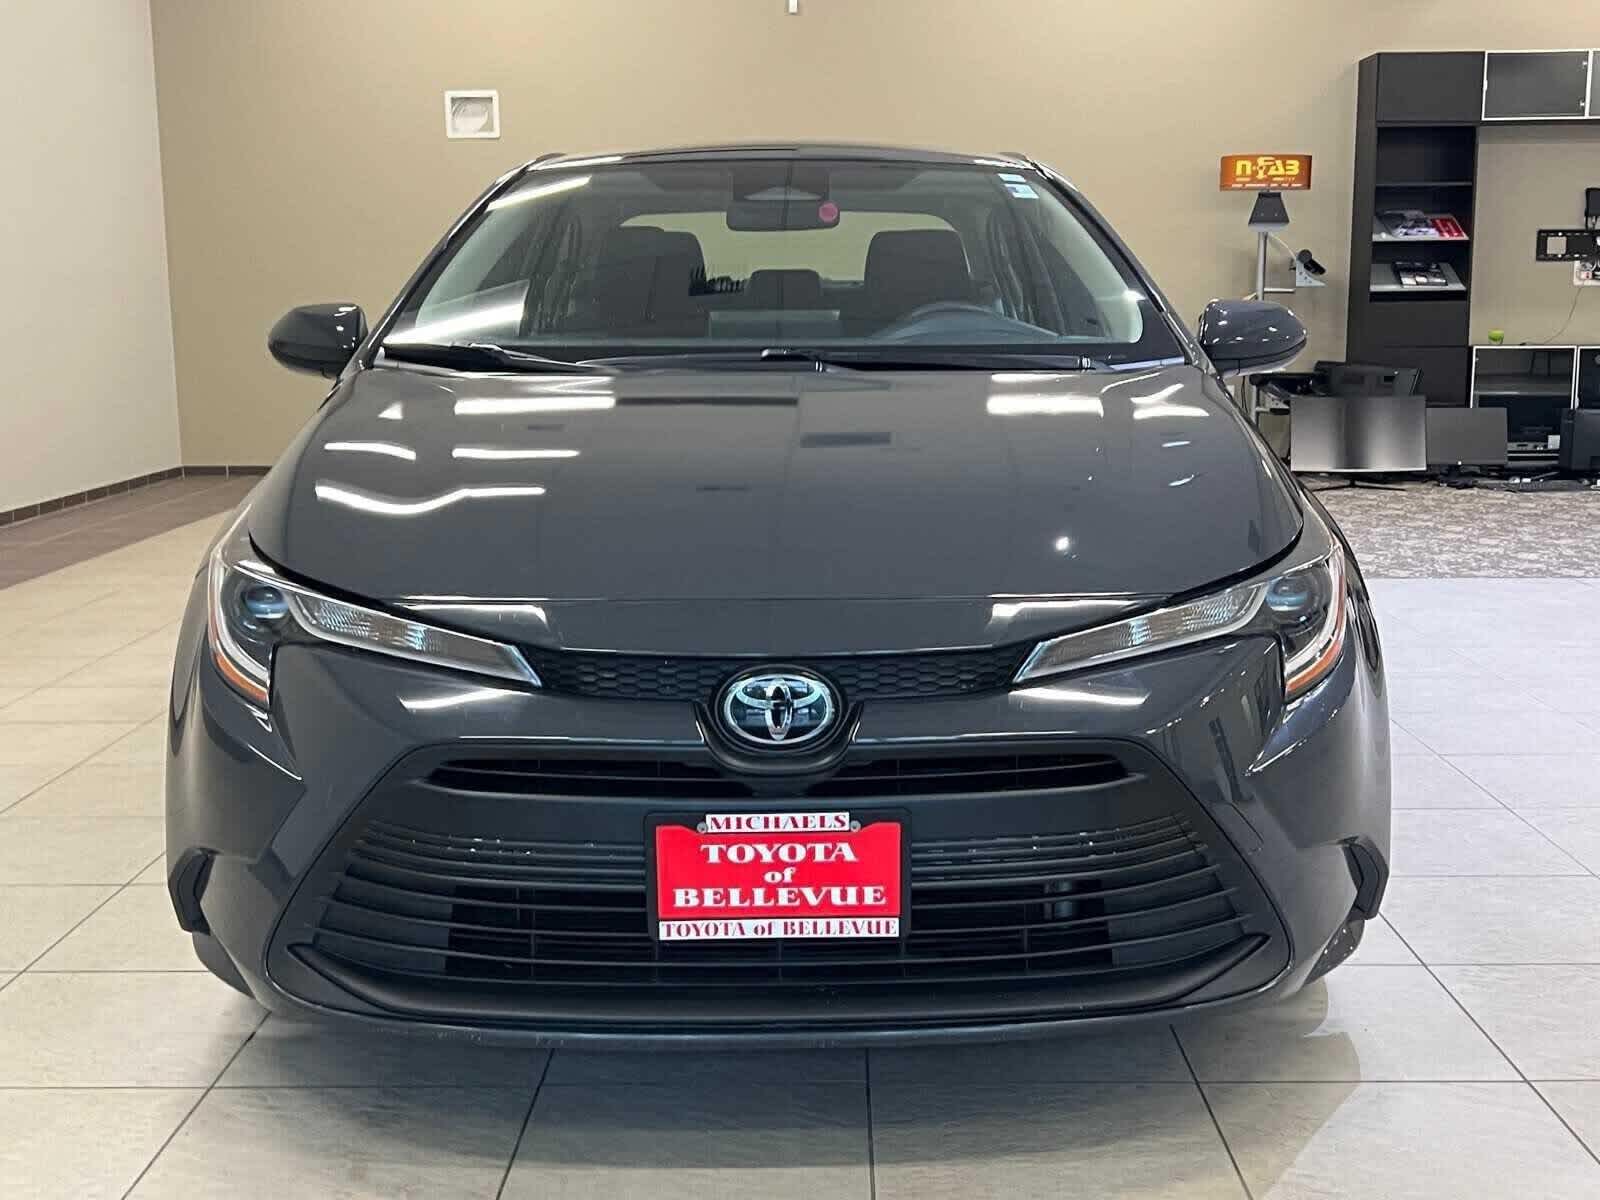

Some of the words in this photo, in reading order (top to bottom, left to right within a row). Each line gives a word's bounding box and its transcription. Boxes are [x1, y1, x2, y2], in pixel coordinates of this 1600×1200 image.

[710, 814, 847, 831] MICHAELS
[700, 842, 858, 863] TOYOTA
[764, 867, 796, 883] of
[673, 885, 886, 907] BELLEVUE
[661, 922, 746, 938] TOYOTA
[753, 921, 773, 936] of
[783, 919, 897, 935] BELLEVUE
